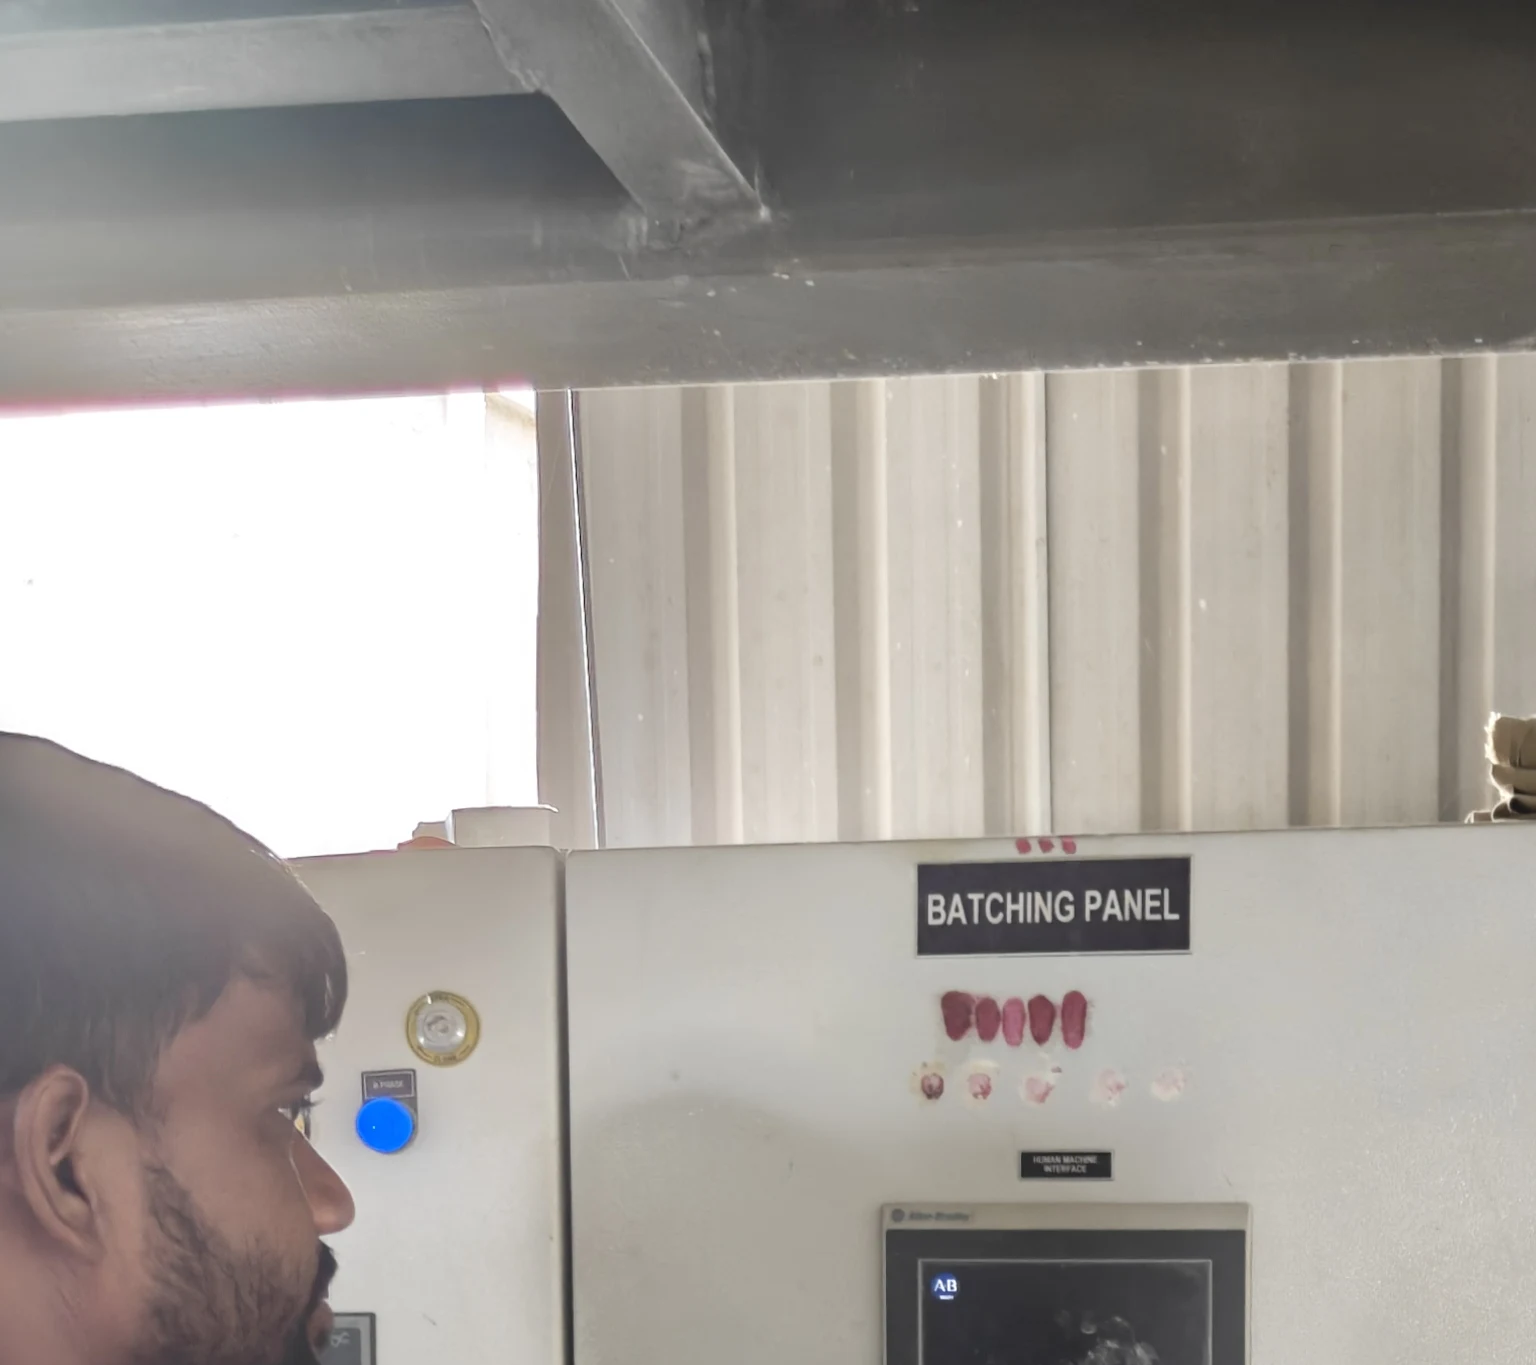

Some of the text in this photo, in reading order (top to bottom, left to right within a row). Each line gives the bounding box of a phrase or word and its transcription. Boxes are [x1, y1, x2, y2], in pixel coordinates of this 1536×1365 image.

[927, 888, 1180, 926] BATCHING PANEL
[1033, 1155, 1098, 1164] HUMAN MACHINE
[1043, 1164, 1087, 1173] INTERFACE
